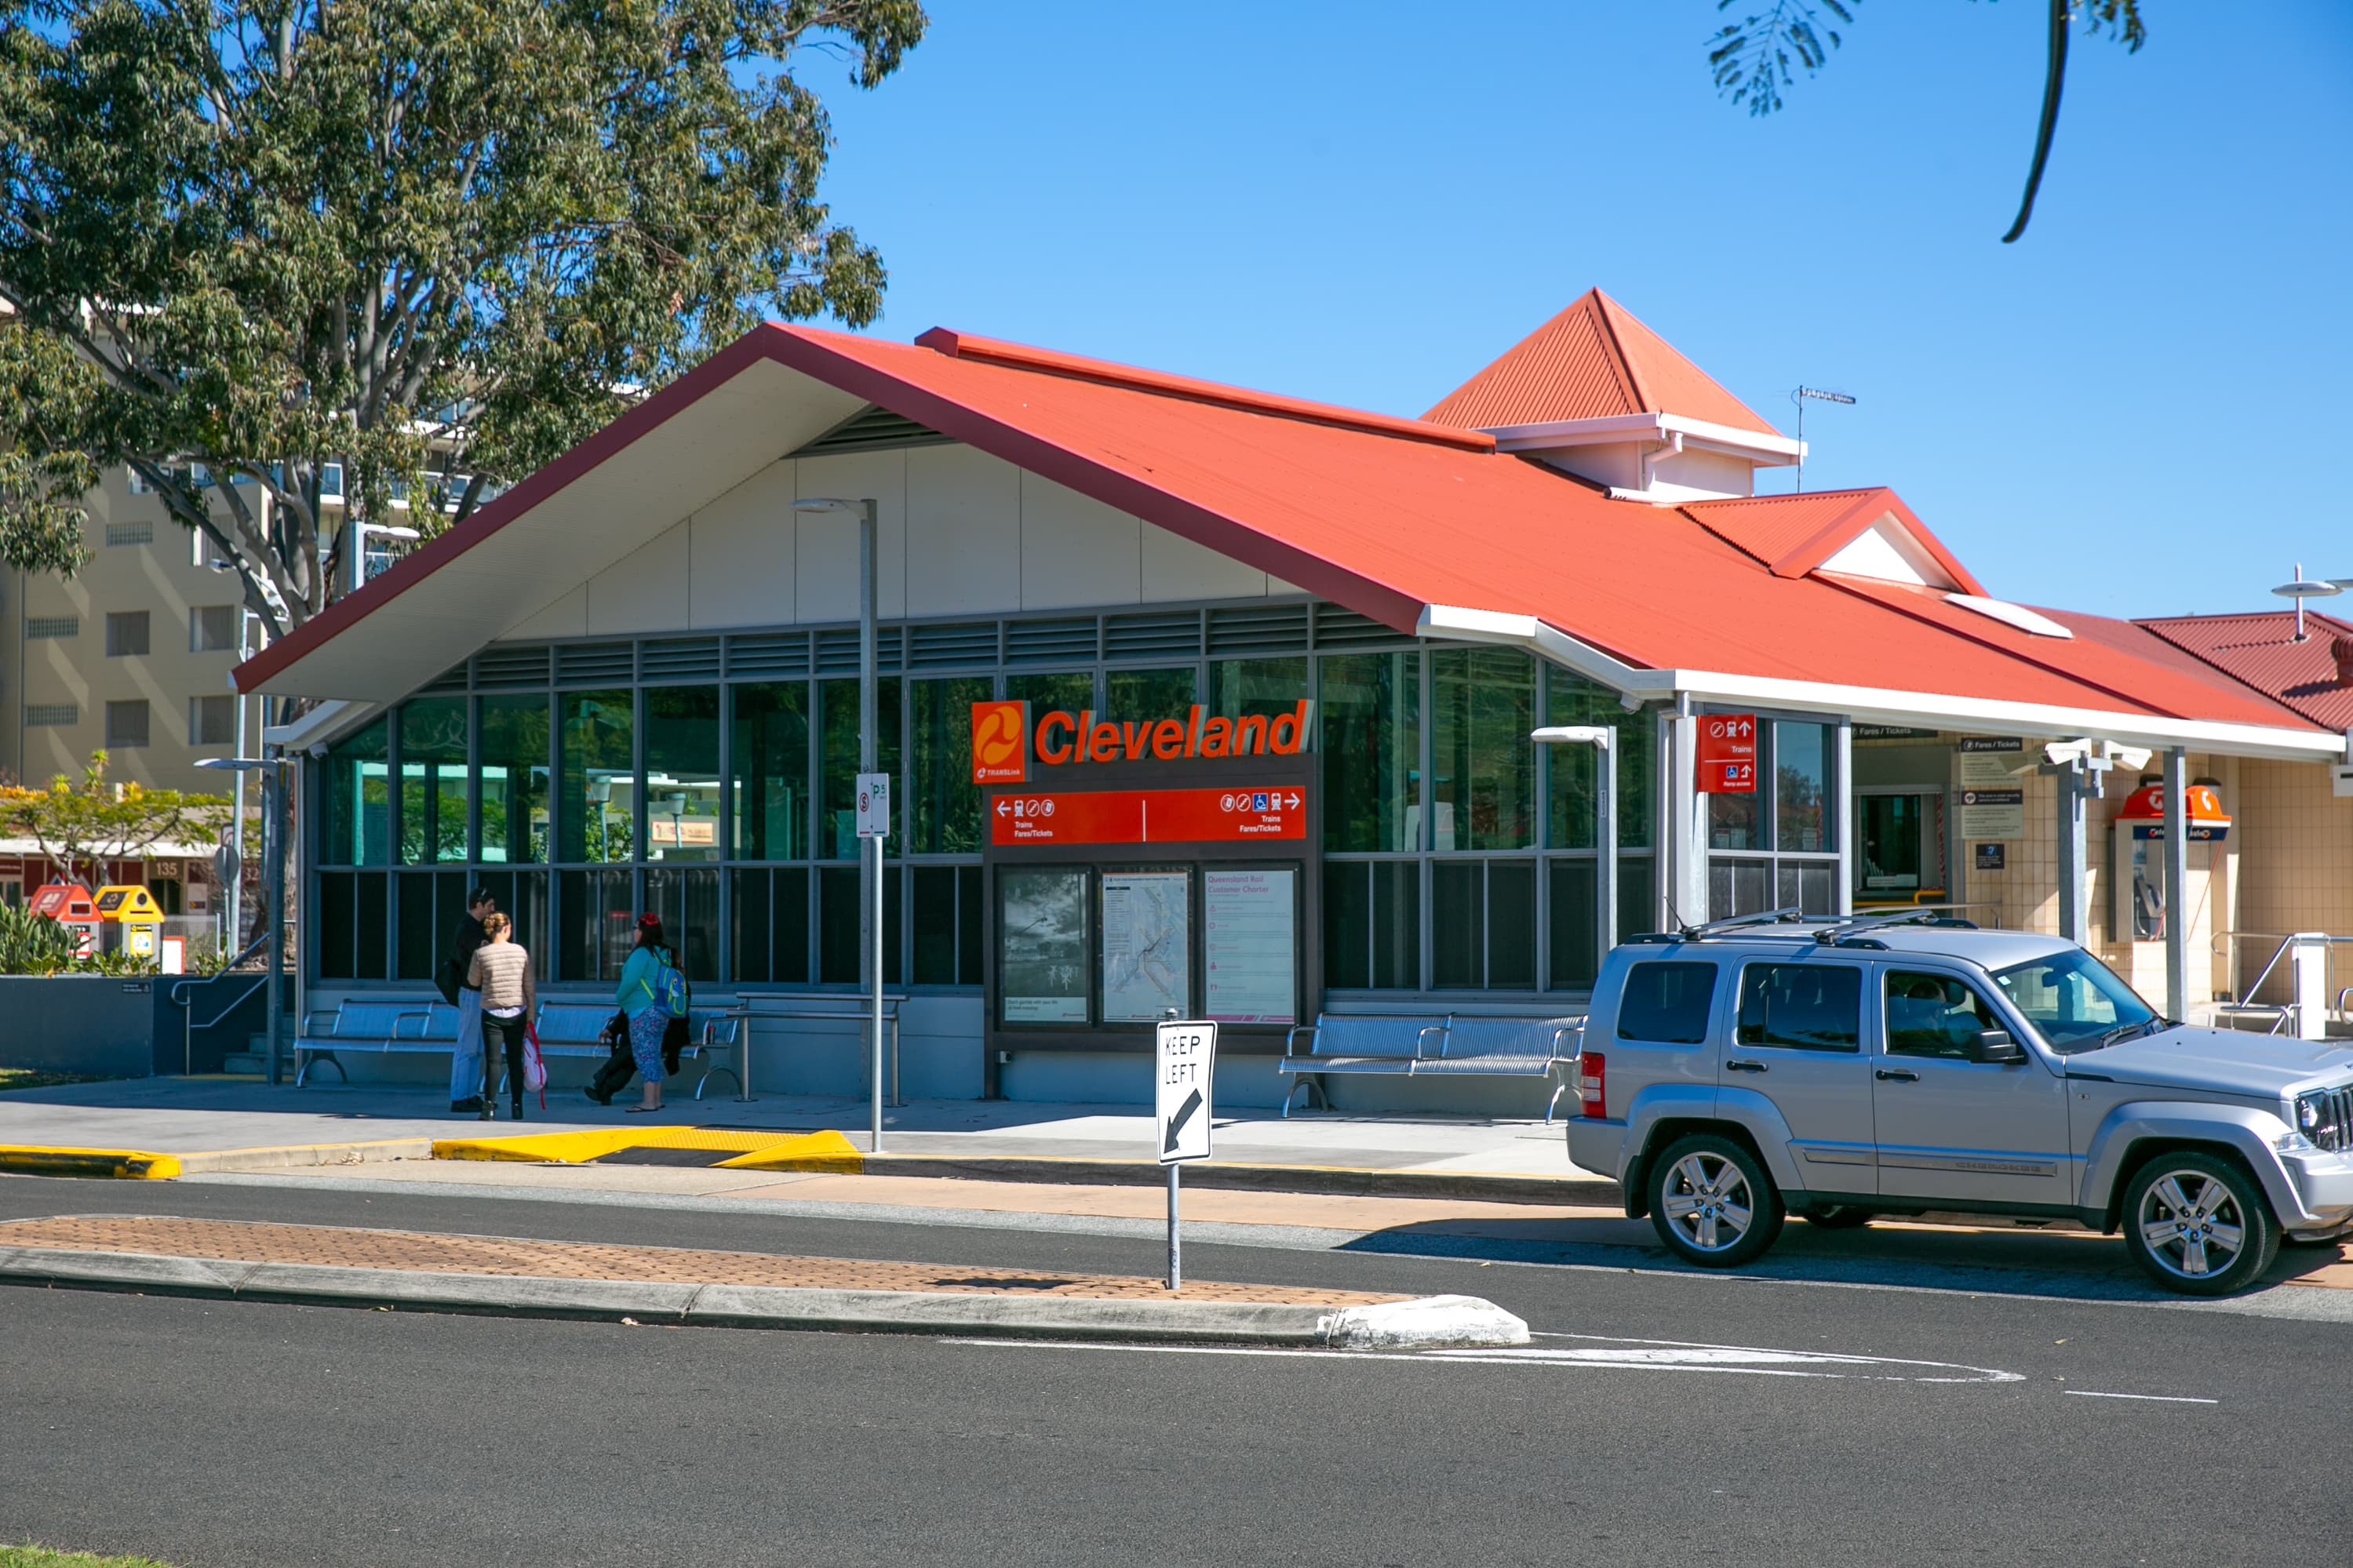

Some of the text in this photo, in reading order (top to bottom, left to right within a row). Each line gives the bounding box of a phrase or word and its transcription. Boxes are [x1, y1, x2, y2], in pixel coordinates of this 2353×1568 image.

[1035, 699, 1309, 766] Cleveland
[873, 784, 886, 799] P 5
[156, 862, 177, 876] 135
[1165, 1035, 1200, 1056] KEEP
[1165, 1063, 1197, 1085] LEFT
